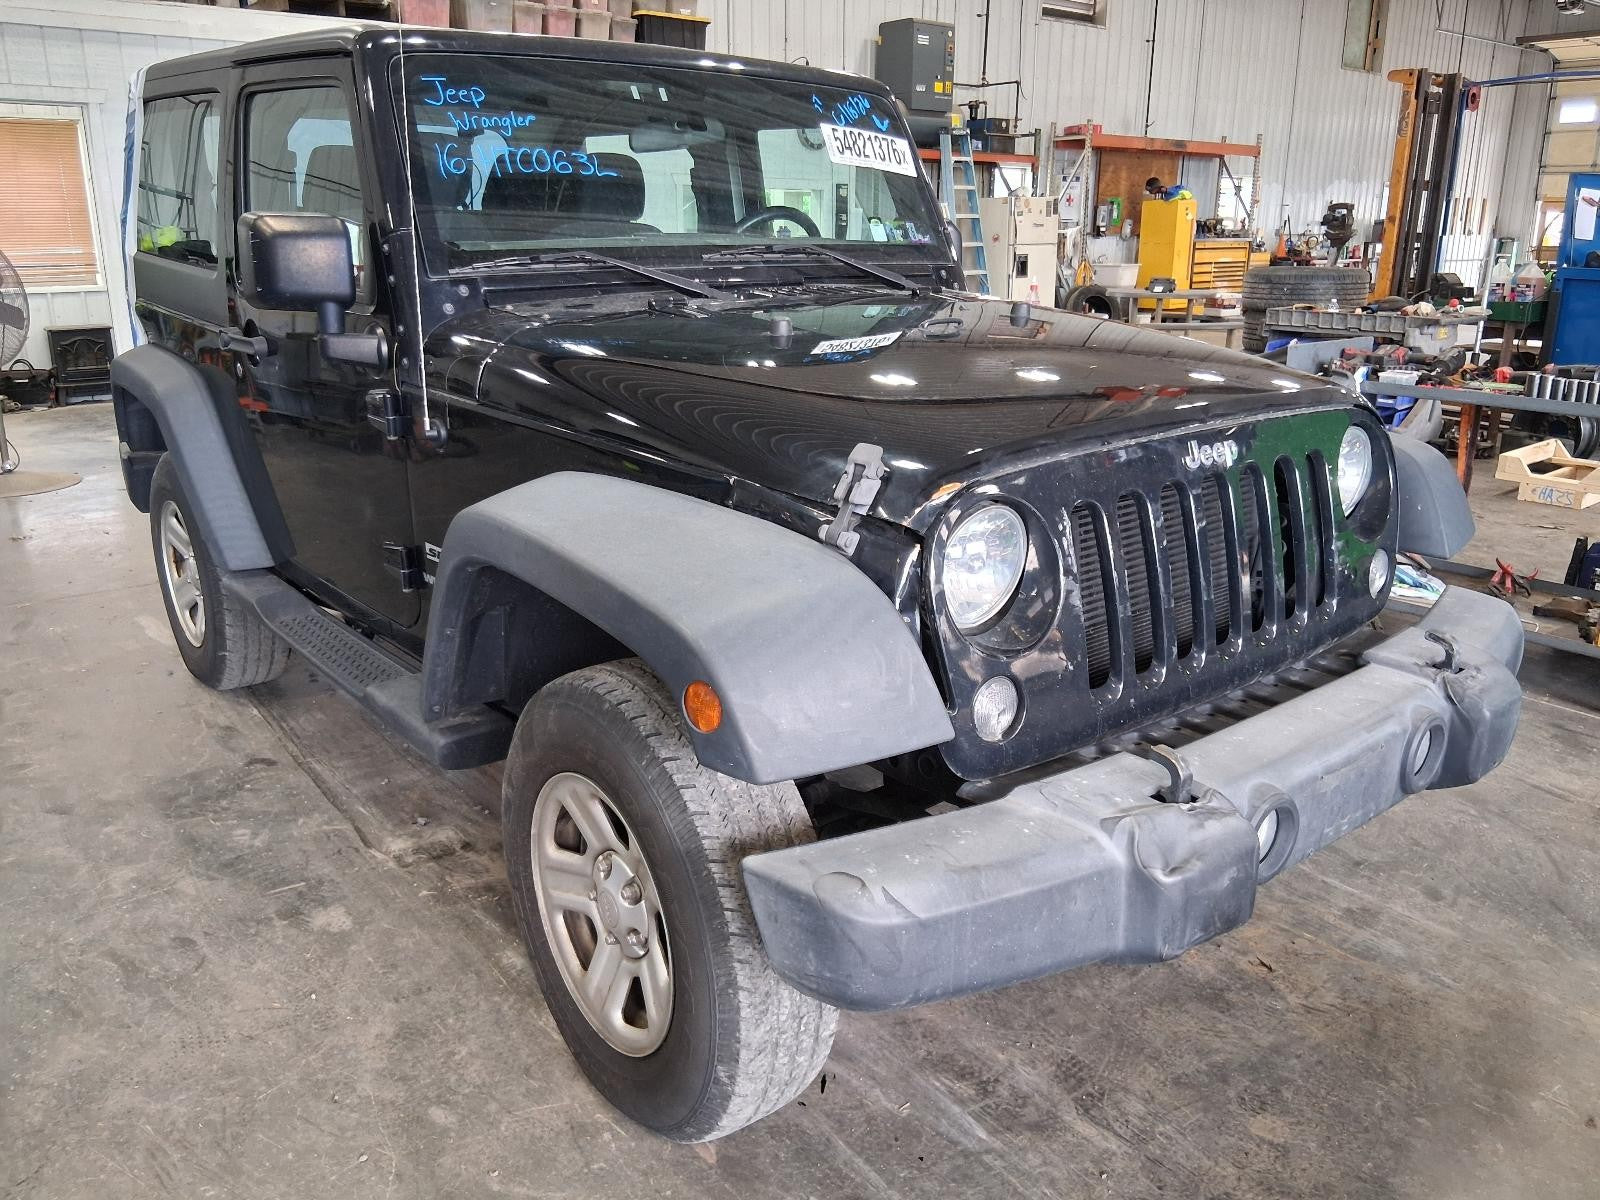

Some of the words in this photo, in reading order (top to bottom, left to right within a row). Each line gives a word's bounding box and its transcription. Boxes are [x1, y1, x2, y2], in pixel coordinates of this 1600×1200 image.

[421, 76, 485, 108] Jeep
[448, 111, 536, 136] Wrangler
[1182, 440, 1238, 471] Jeep
